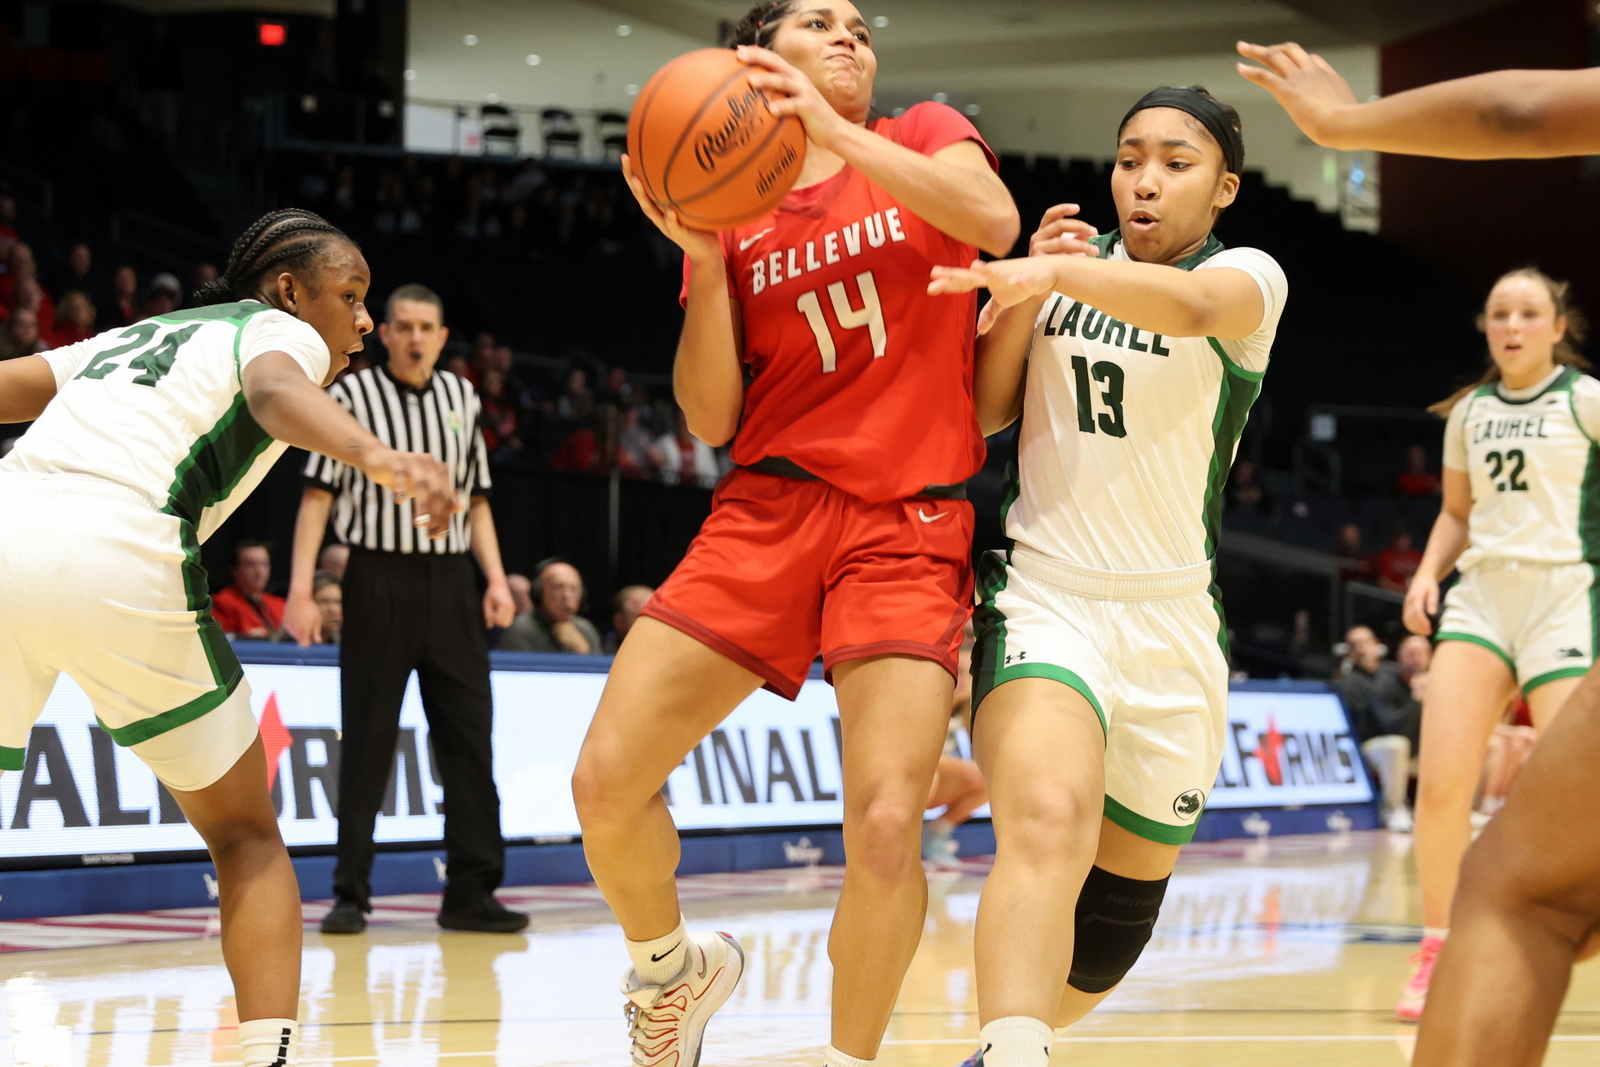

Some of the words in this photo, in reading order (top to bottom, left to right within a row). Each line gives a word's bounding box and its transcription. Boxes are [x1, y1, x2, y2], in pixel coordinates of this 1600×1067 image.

[695, 82, 771, 172] Rawling
[752, 206, 906, 296] BELLEVUE
[73, 323, 204, 388] 24
[797, 270, 887, 374] 14
[1071, 355, 1127, 438] 13
[1485, 449, 1529, 492] 22
[660, 717, 843, 806] INAL
